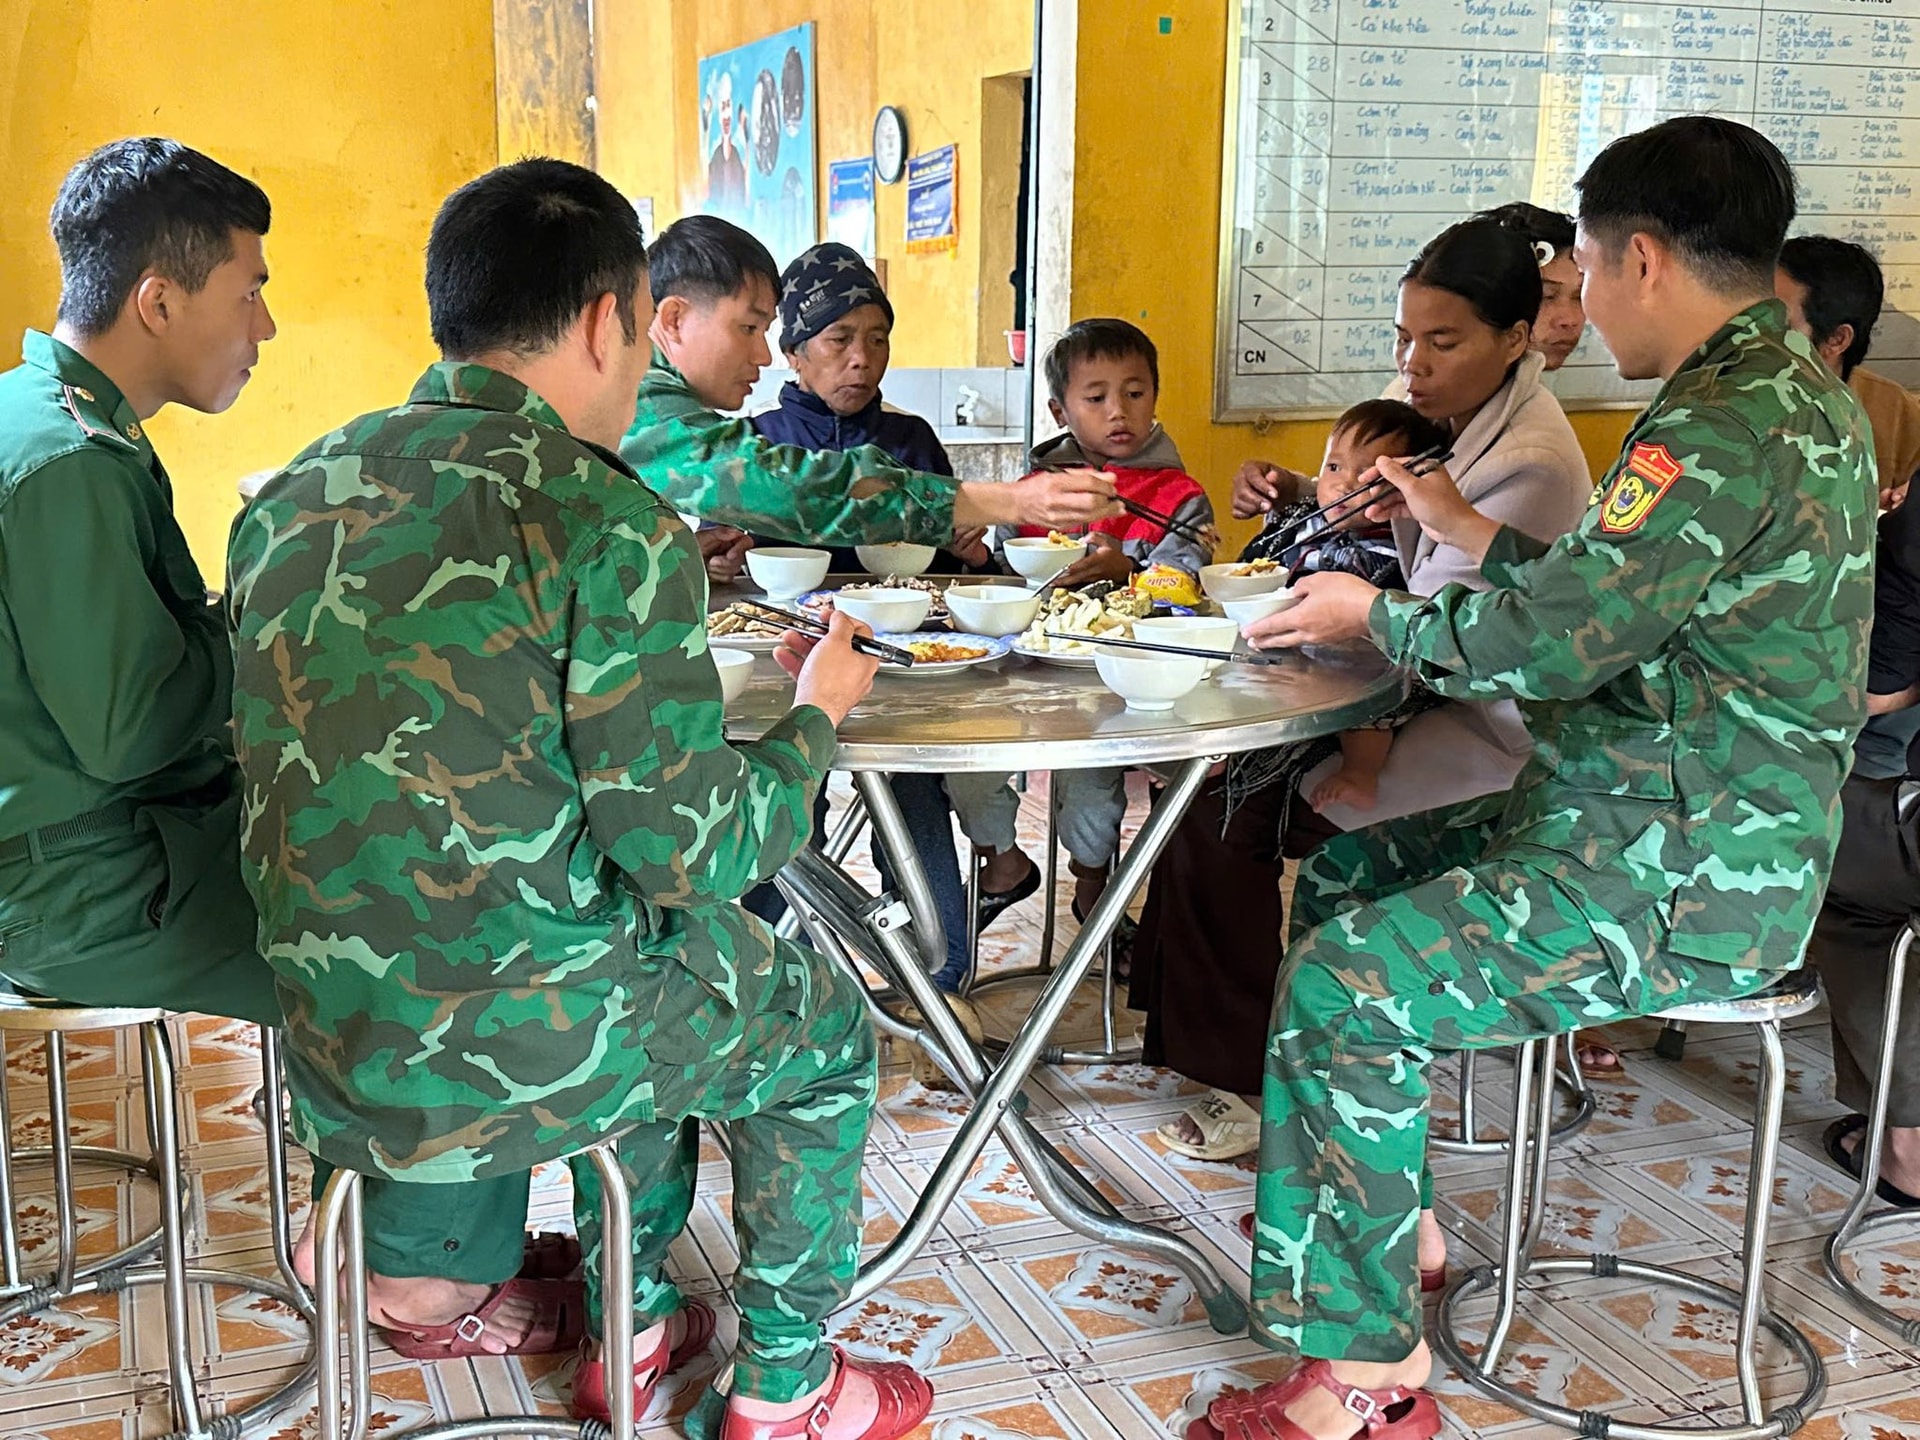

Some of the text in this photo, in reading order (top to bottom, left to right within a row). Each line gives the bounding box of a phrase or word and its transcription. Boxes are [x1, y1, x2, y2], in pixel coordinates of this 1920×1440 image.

[1265, 18, 1274, 31] 2
[1306, 56, 1330, 72] 28
[1263, 72, 1271, 85] 3
[1305, 112, 1329, 127] 29
[1303, 169, 1323, 185] 30
[1258, 185, 1267, 199] 5
[1302, 222, 1320, 240] 31
[1255, 241, 1264, 254] 6
[1253, 294, 1261, 307] 7
[1293, 329, 1311, 345] 02
[1244, 350, 1266, 363] CN
